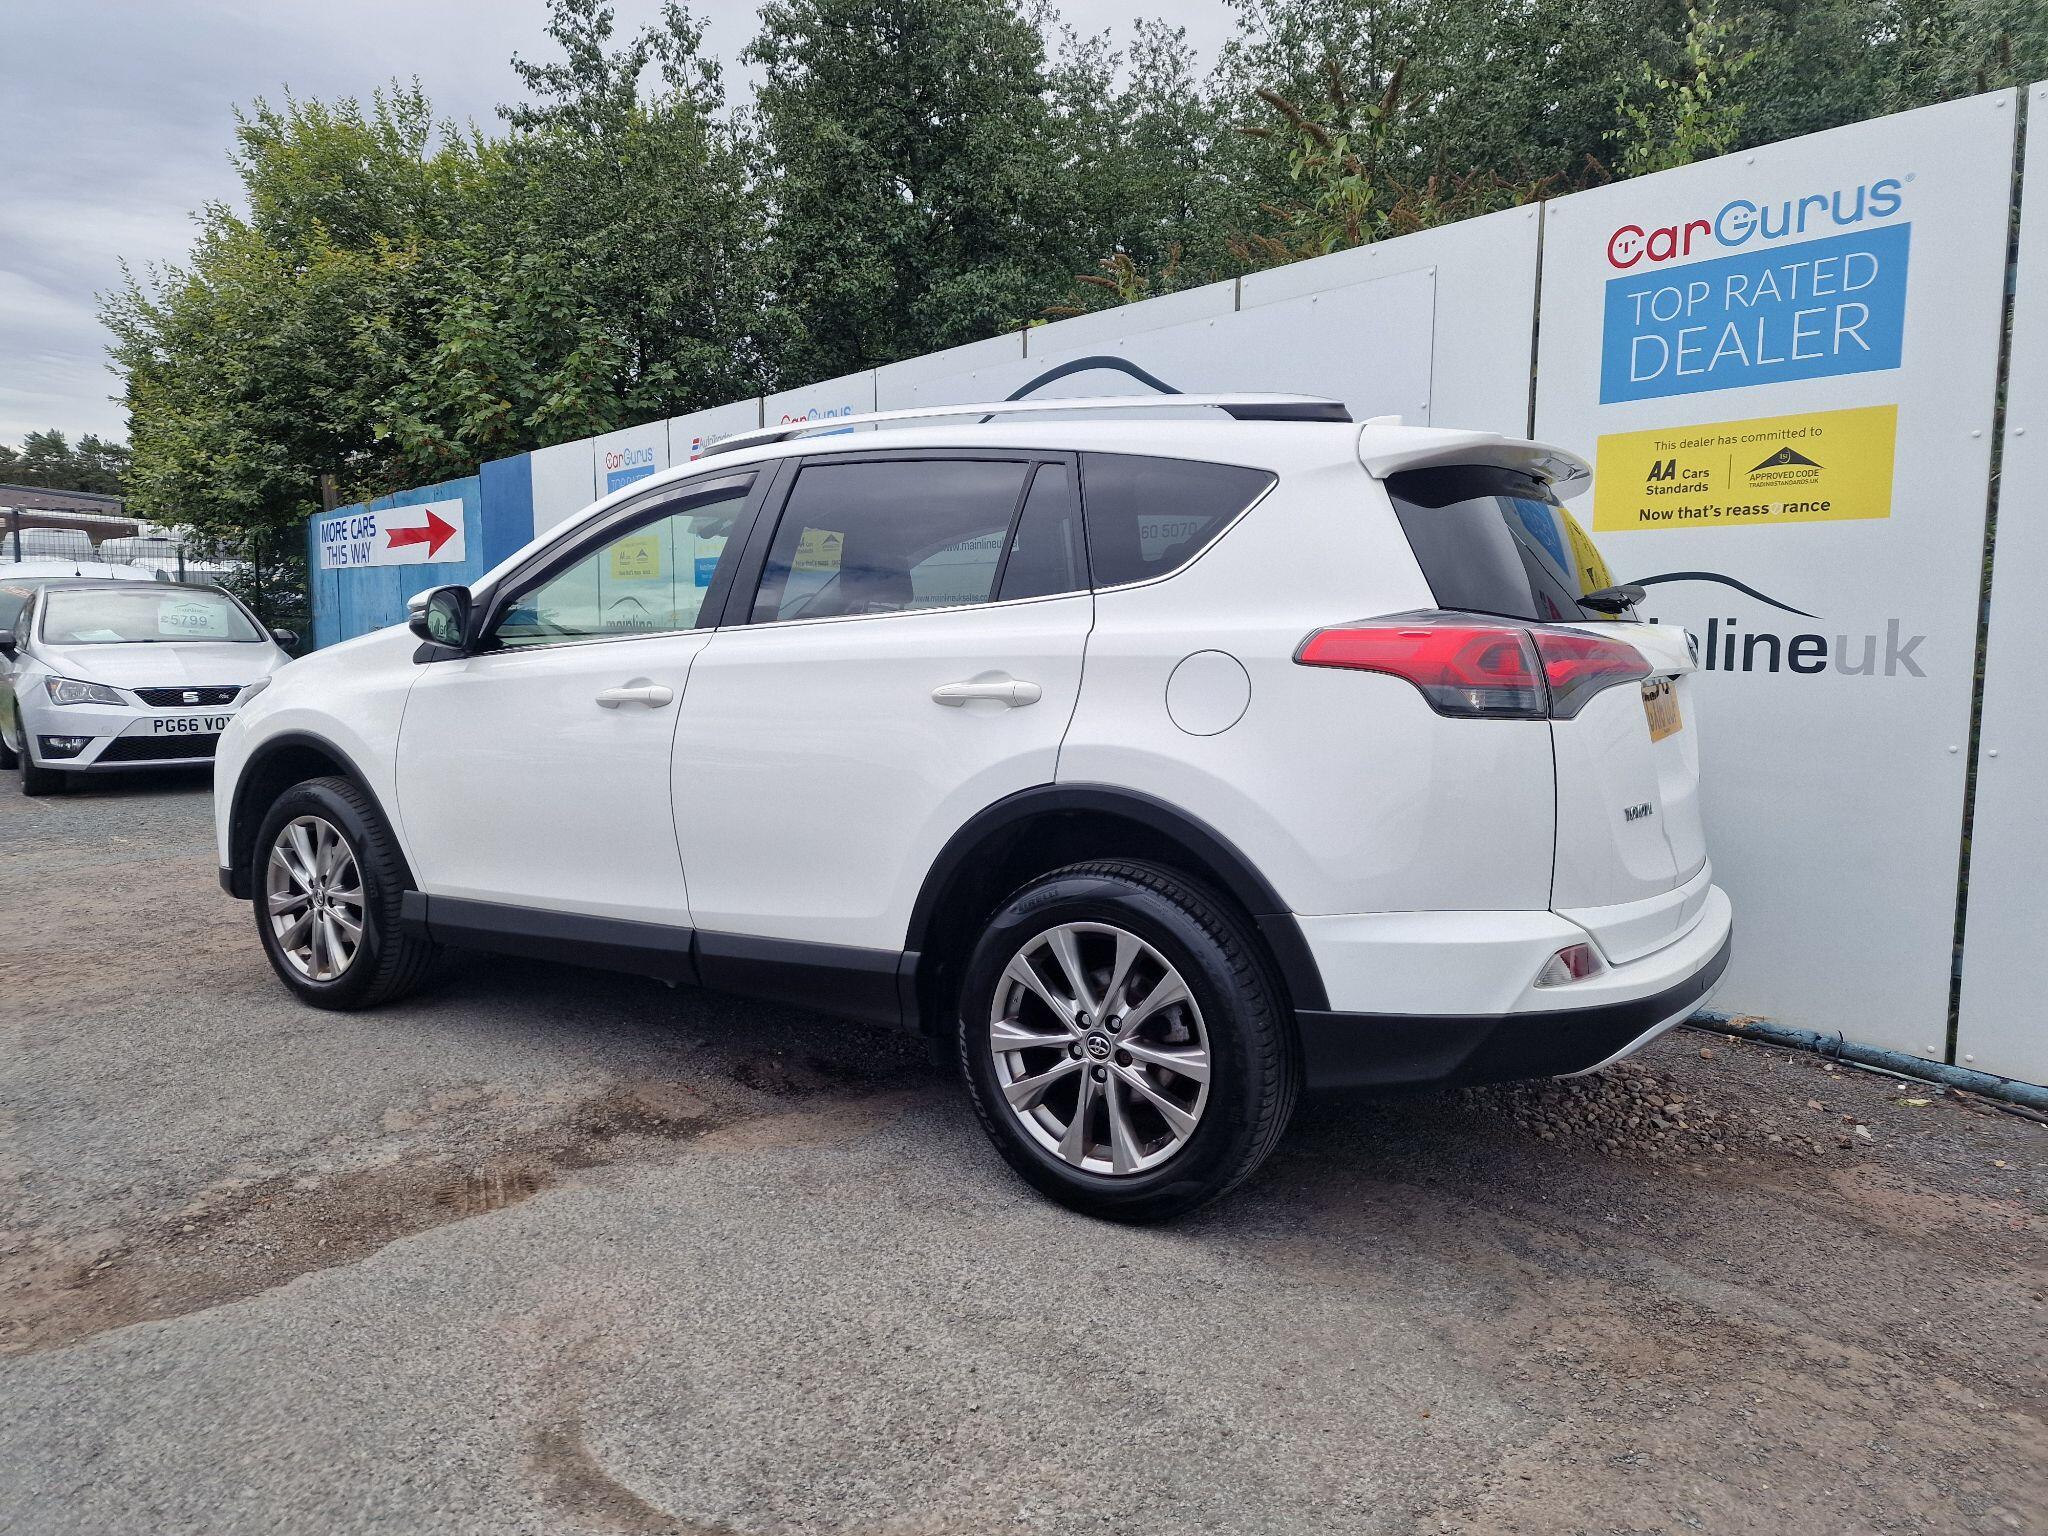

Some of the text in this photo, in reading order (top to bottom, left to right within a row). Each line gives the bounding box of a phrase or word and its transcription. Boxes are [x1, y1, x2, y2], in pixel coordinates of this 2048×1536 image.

[1607, 178, 1902, 269] CarGurus
[1627, 252, 1879, 326] TOP RATED
[1630, 302, 1871, 382] DEALER
[1654, 426, 1823, 451] This dealer has committed to
[605, 447, 653, 470] CarGurus
[1646, 458, 1710, 483] AA Cars
[1749, 468, 1820, 481] APPROVED CODE
[1646, 481, 1709, 496] Standards
[1639, 508, 1674, 521] Now
[1726, 500, 1831, 517] reassrance
[321, 515, 377, 544] MORE CARS
[326, 541, 372, 566] THIS WAY
[1649, 617, 1928, 678] lineuk
[153, 718, 199, 734] PG66
